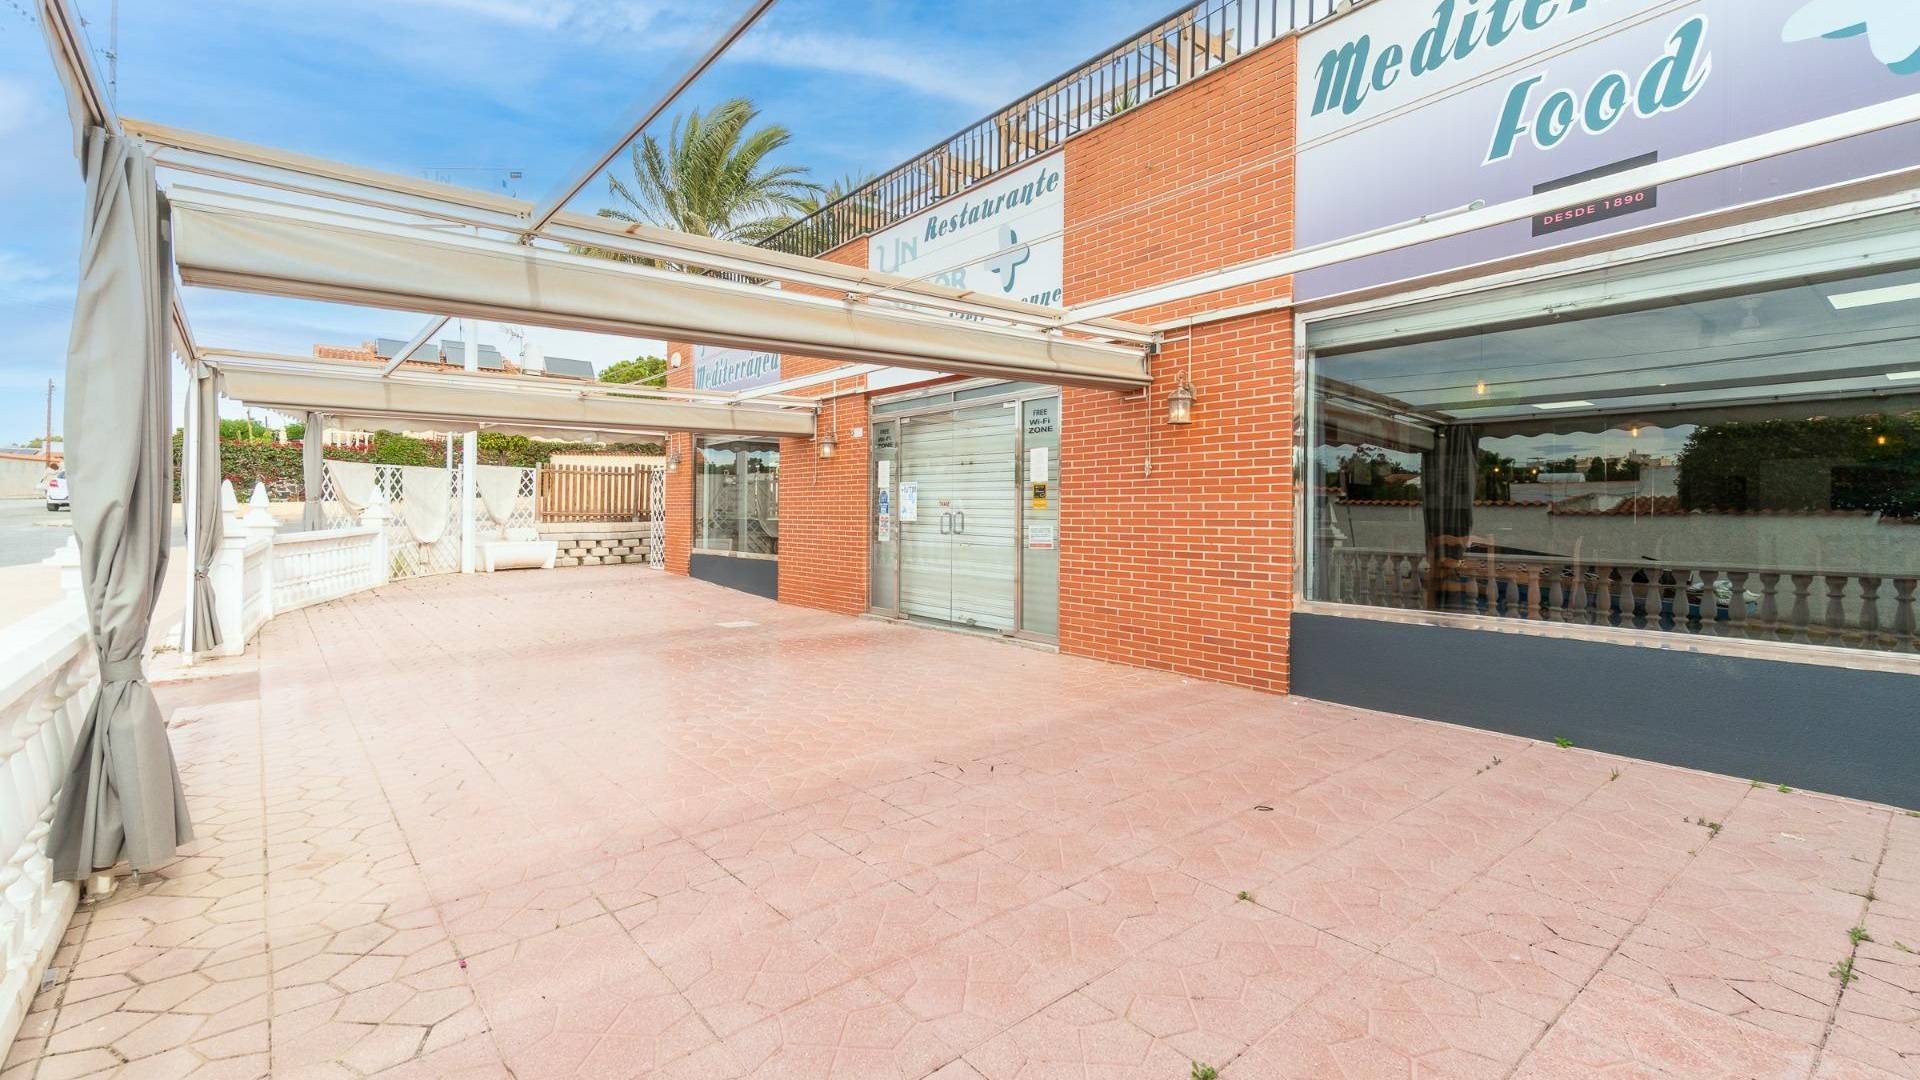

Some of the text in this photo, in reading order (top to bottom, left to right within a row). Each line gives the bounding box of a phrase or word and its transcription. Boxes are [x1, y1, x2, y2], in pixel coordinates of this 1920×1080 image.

[1310, 0, 1588, 117] Medite
[1486, 17, 1708, 164] Food
[924, 167, 1060, 243] Restaurante
[1543, 191, 1646, 226] DESDE 1890
[1028, 425, 1053, 434] ZONE
[1032, 408, 1048, 416] FREE
